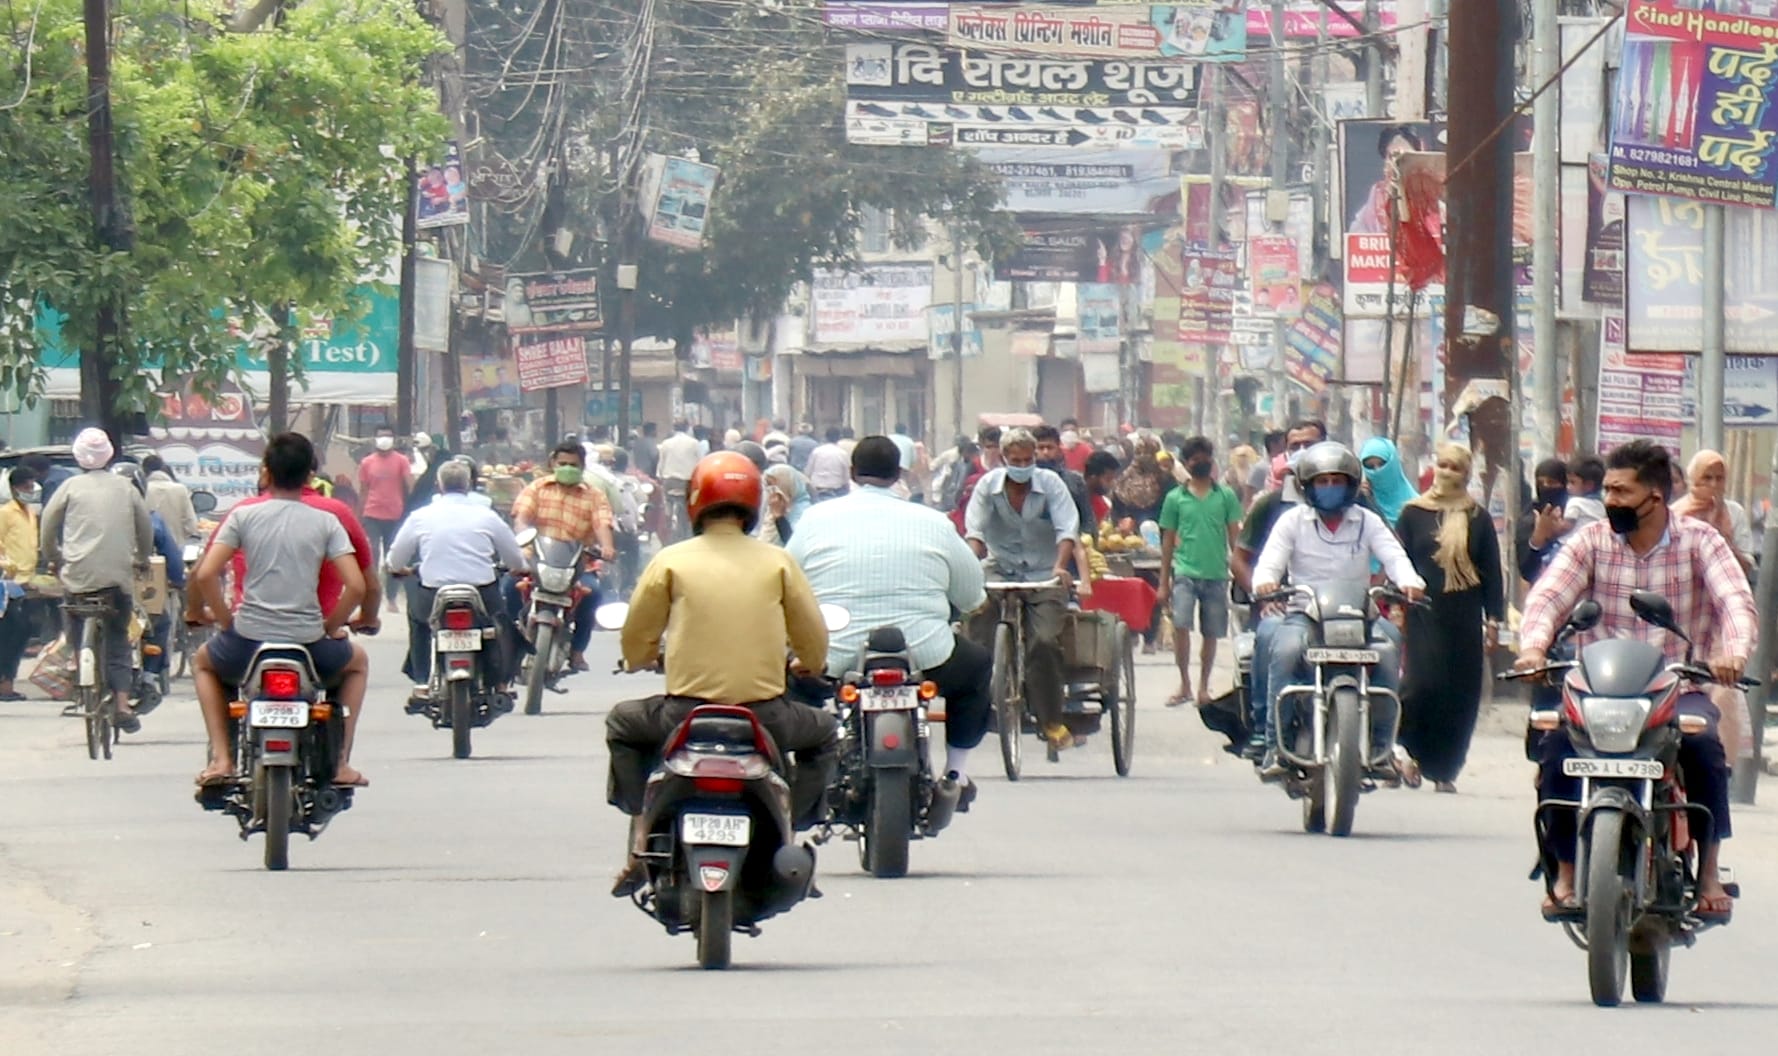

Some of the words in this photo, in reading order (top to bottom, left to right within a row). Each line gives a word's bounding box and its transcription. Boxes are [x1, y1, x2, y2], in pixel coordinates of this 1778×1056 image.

[1070, 16, 1114, 47] मशीन
[897, 45, 948, 85] दि
[1711, 83, 1765, 126] ही
[963, 130, 999, 143] शॉप
[1613, 146, 1627, 159] M.
[1629, 149, 1699, 168] 8279821681
[1698, 128, 1777, 173] पर्दे
[1612, 164, 1639, 178] Shop
[1668, 172, 1706, 185] Krishna
[1707, 177, 1741, 190] Central
[1742, 181, 1774, 194] Market
[1637, 180, 1666, 192] Petrol
[1698, 187, 1720, 198] Civil
[1721, 190, 1742, 202] Line
[304, 339, 381, 368] Test)
[258, 716, 300, 725] 4776
[1615, 762, 1623, 774] L
[694, 829, 737, 842] 4295
